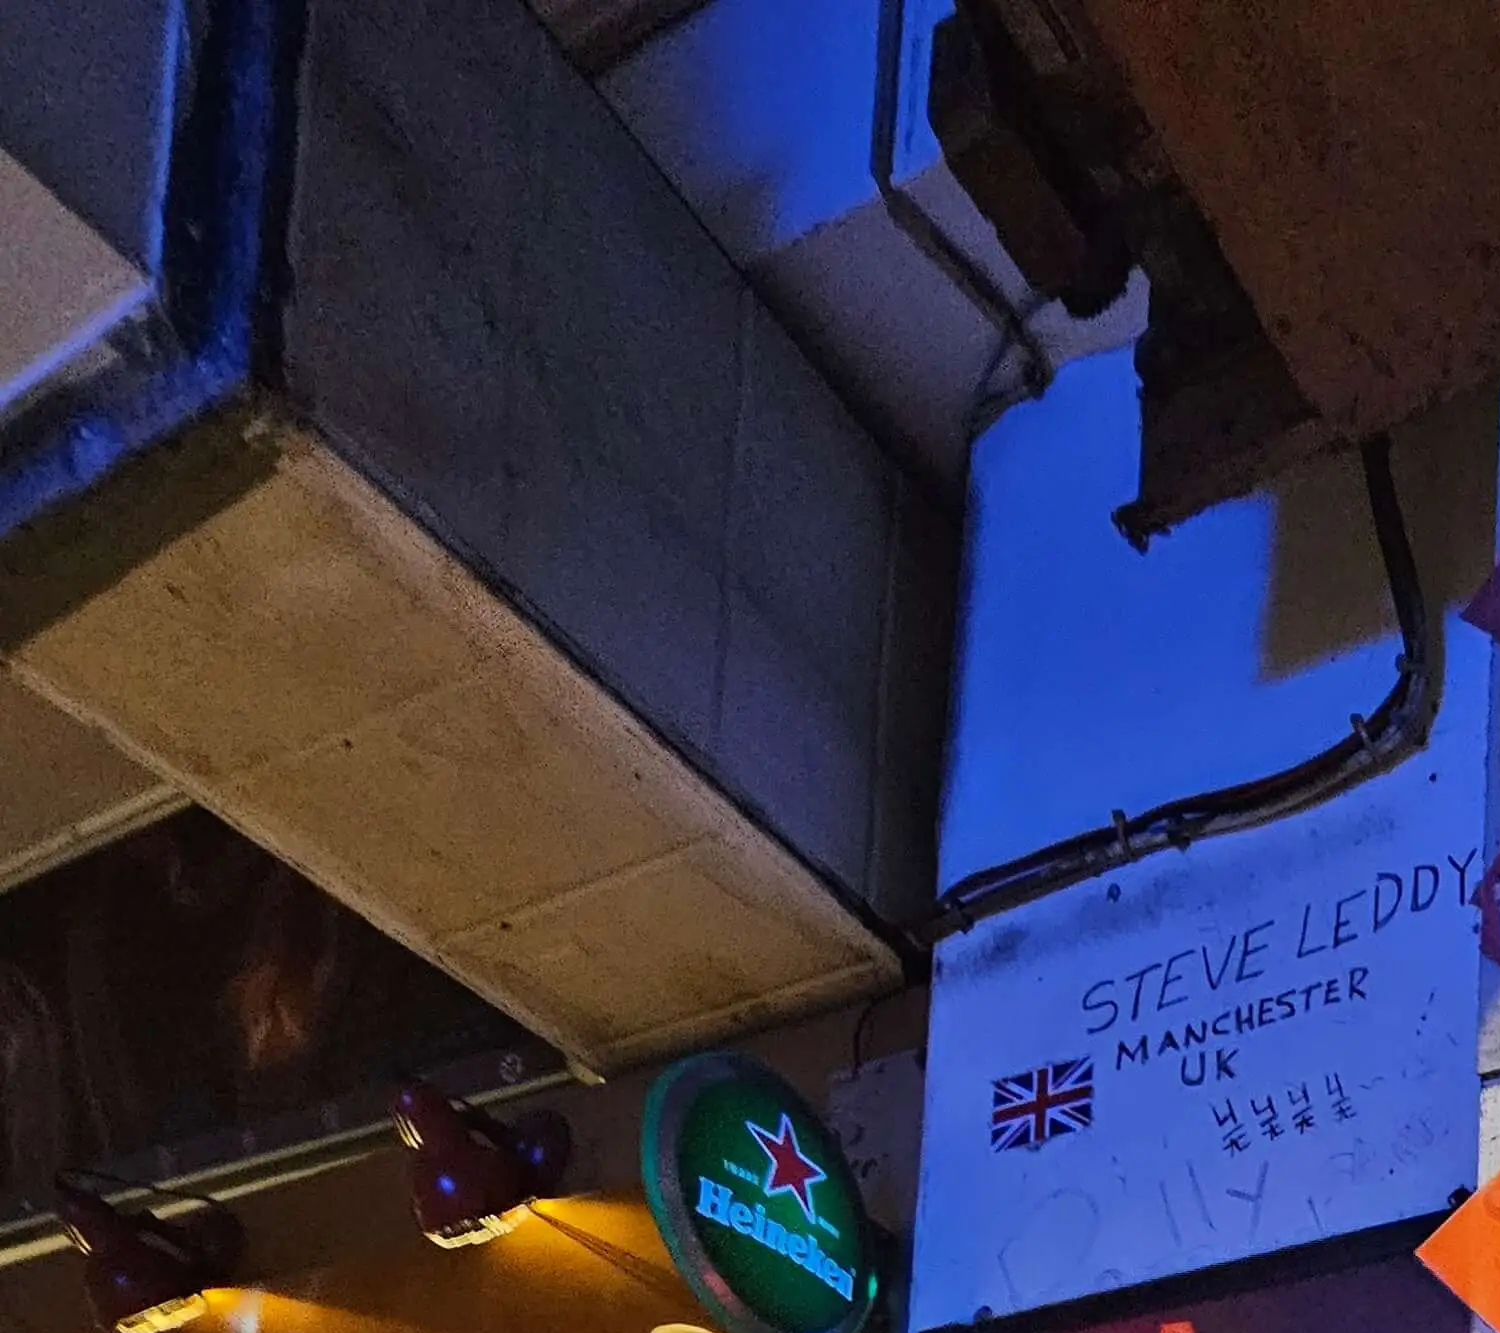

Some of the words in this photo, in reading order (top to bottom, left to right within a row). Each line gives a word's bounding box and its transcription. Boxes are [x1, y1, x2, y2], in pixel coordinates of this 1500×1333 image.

[1081, 920, 1275, 1035] STEVE
[1296, 847, 1479, 960] LEDDY
[1115, 966, 1370, 1071] MANCHESTER
[1180, 1047, 1240, 1088] UK
[695, 1175, 854, 1302] Heineken
